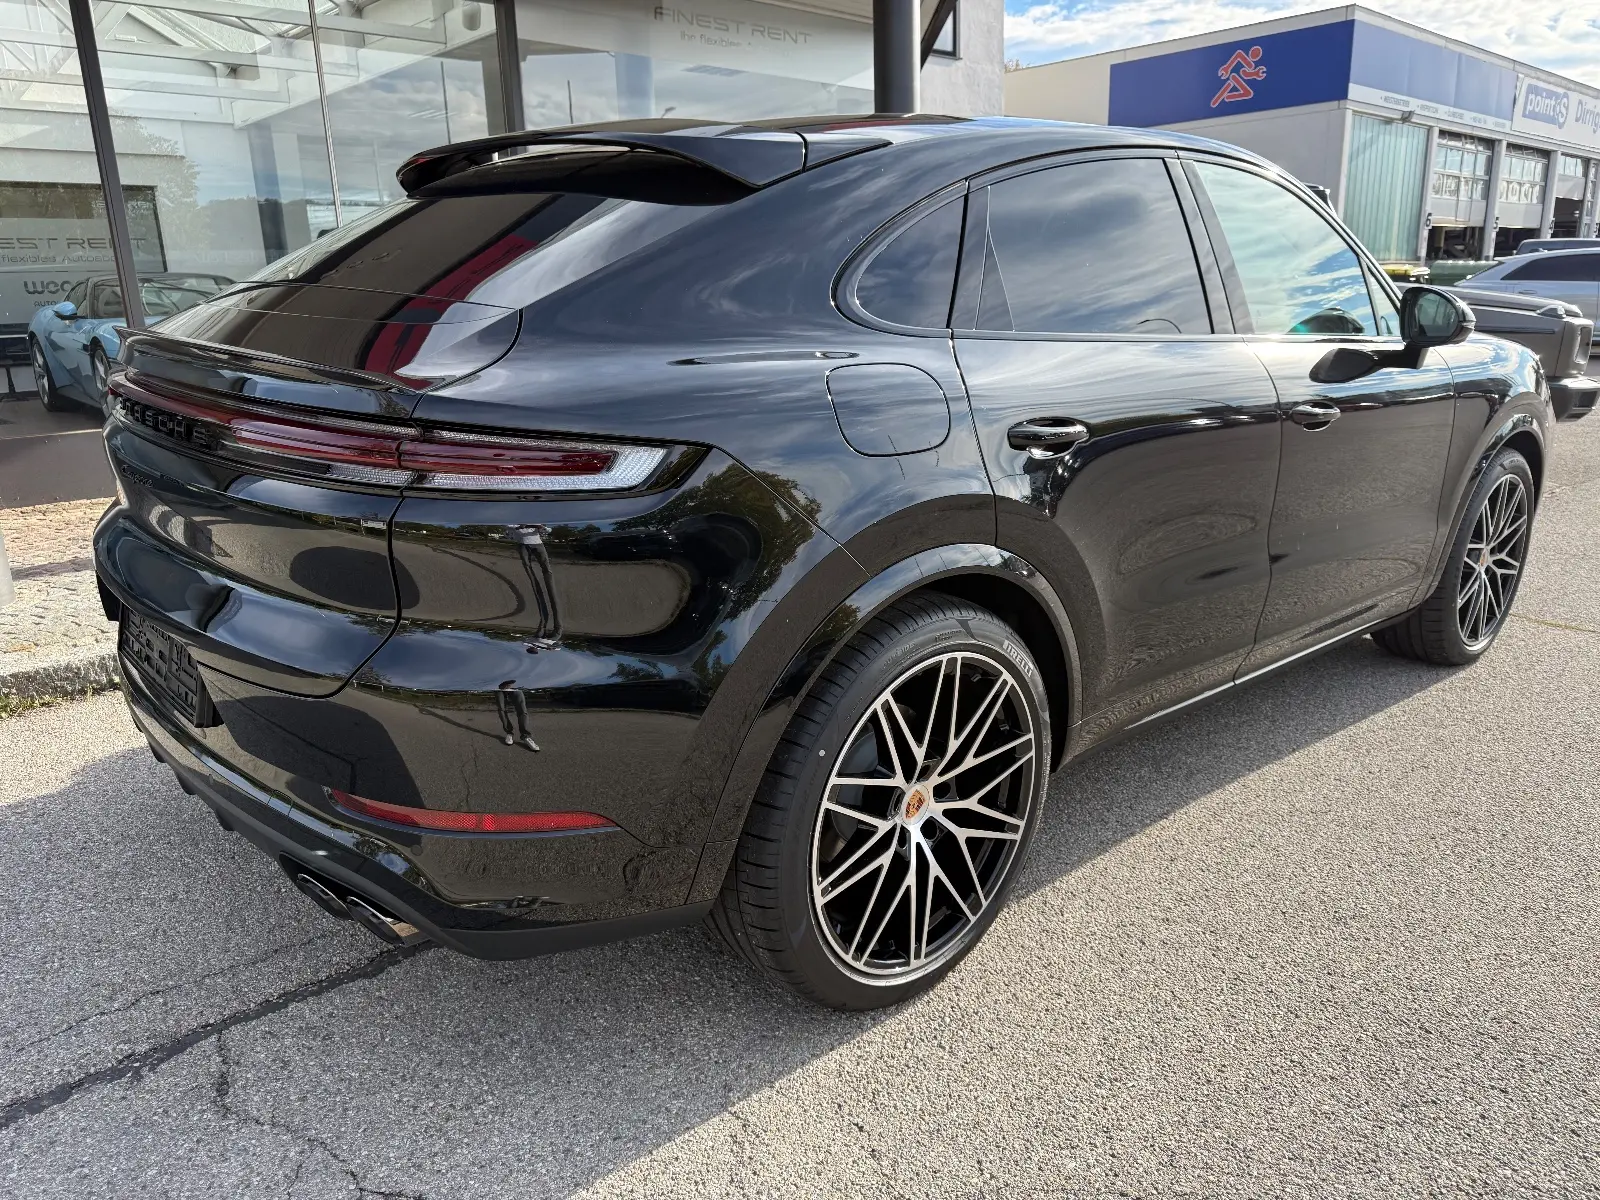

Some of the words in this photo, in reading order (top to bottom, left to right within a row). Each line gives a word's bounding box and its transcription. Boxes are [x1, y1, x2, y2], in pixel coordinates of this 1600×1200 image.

[653, 6, 746, 34] FINEST
[751, 24, 812, 44] RENT
[1526, 92, 1555, 116] point
[66, 238, 147, 250] RET
[1, 254, 56, 263] flexibles
[1003, 639, 1034, 678] PIRELLI
